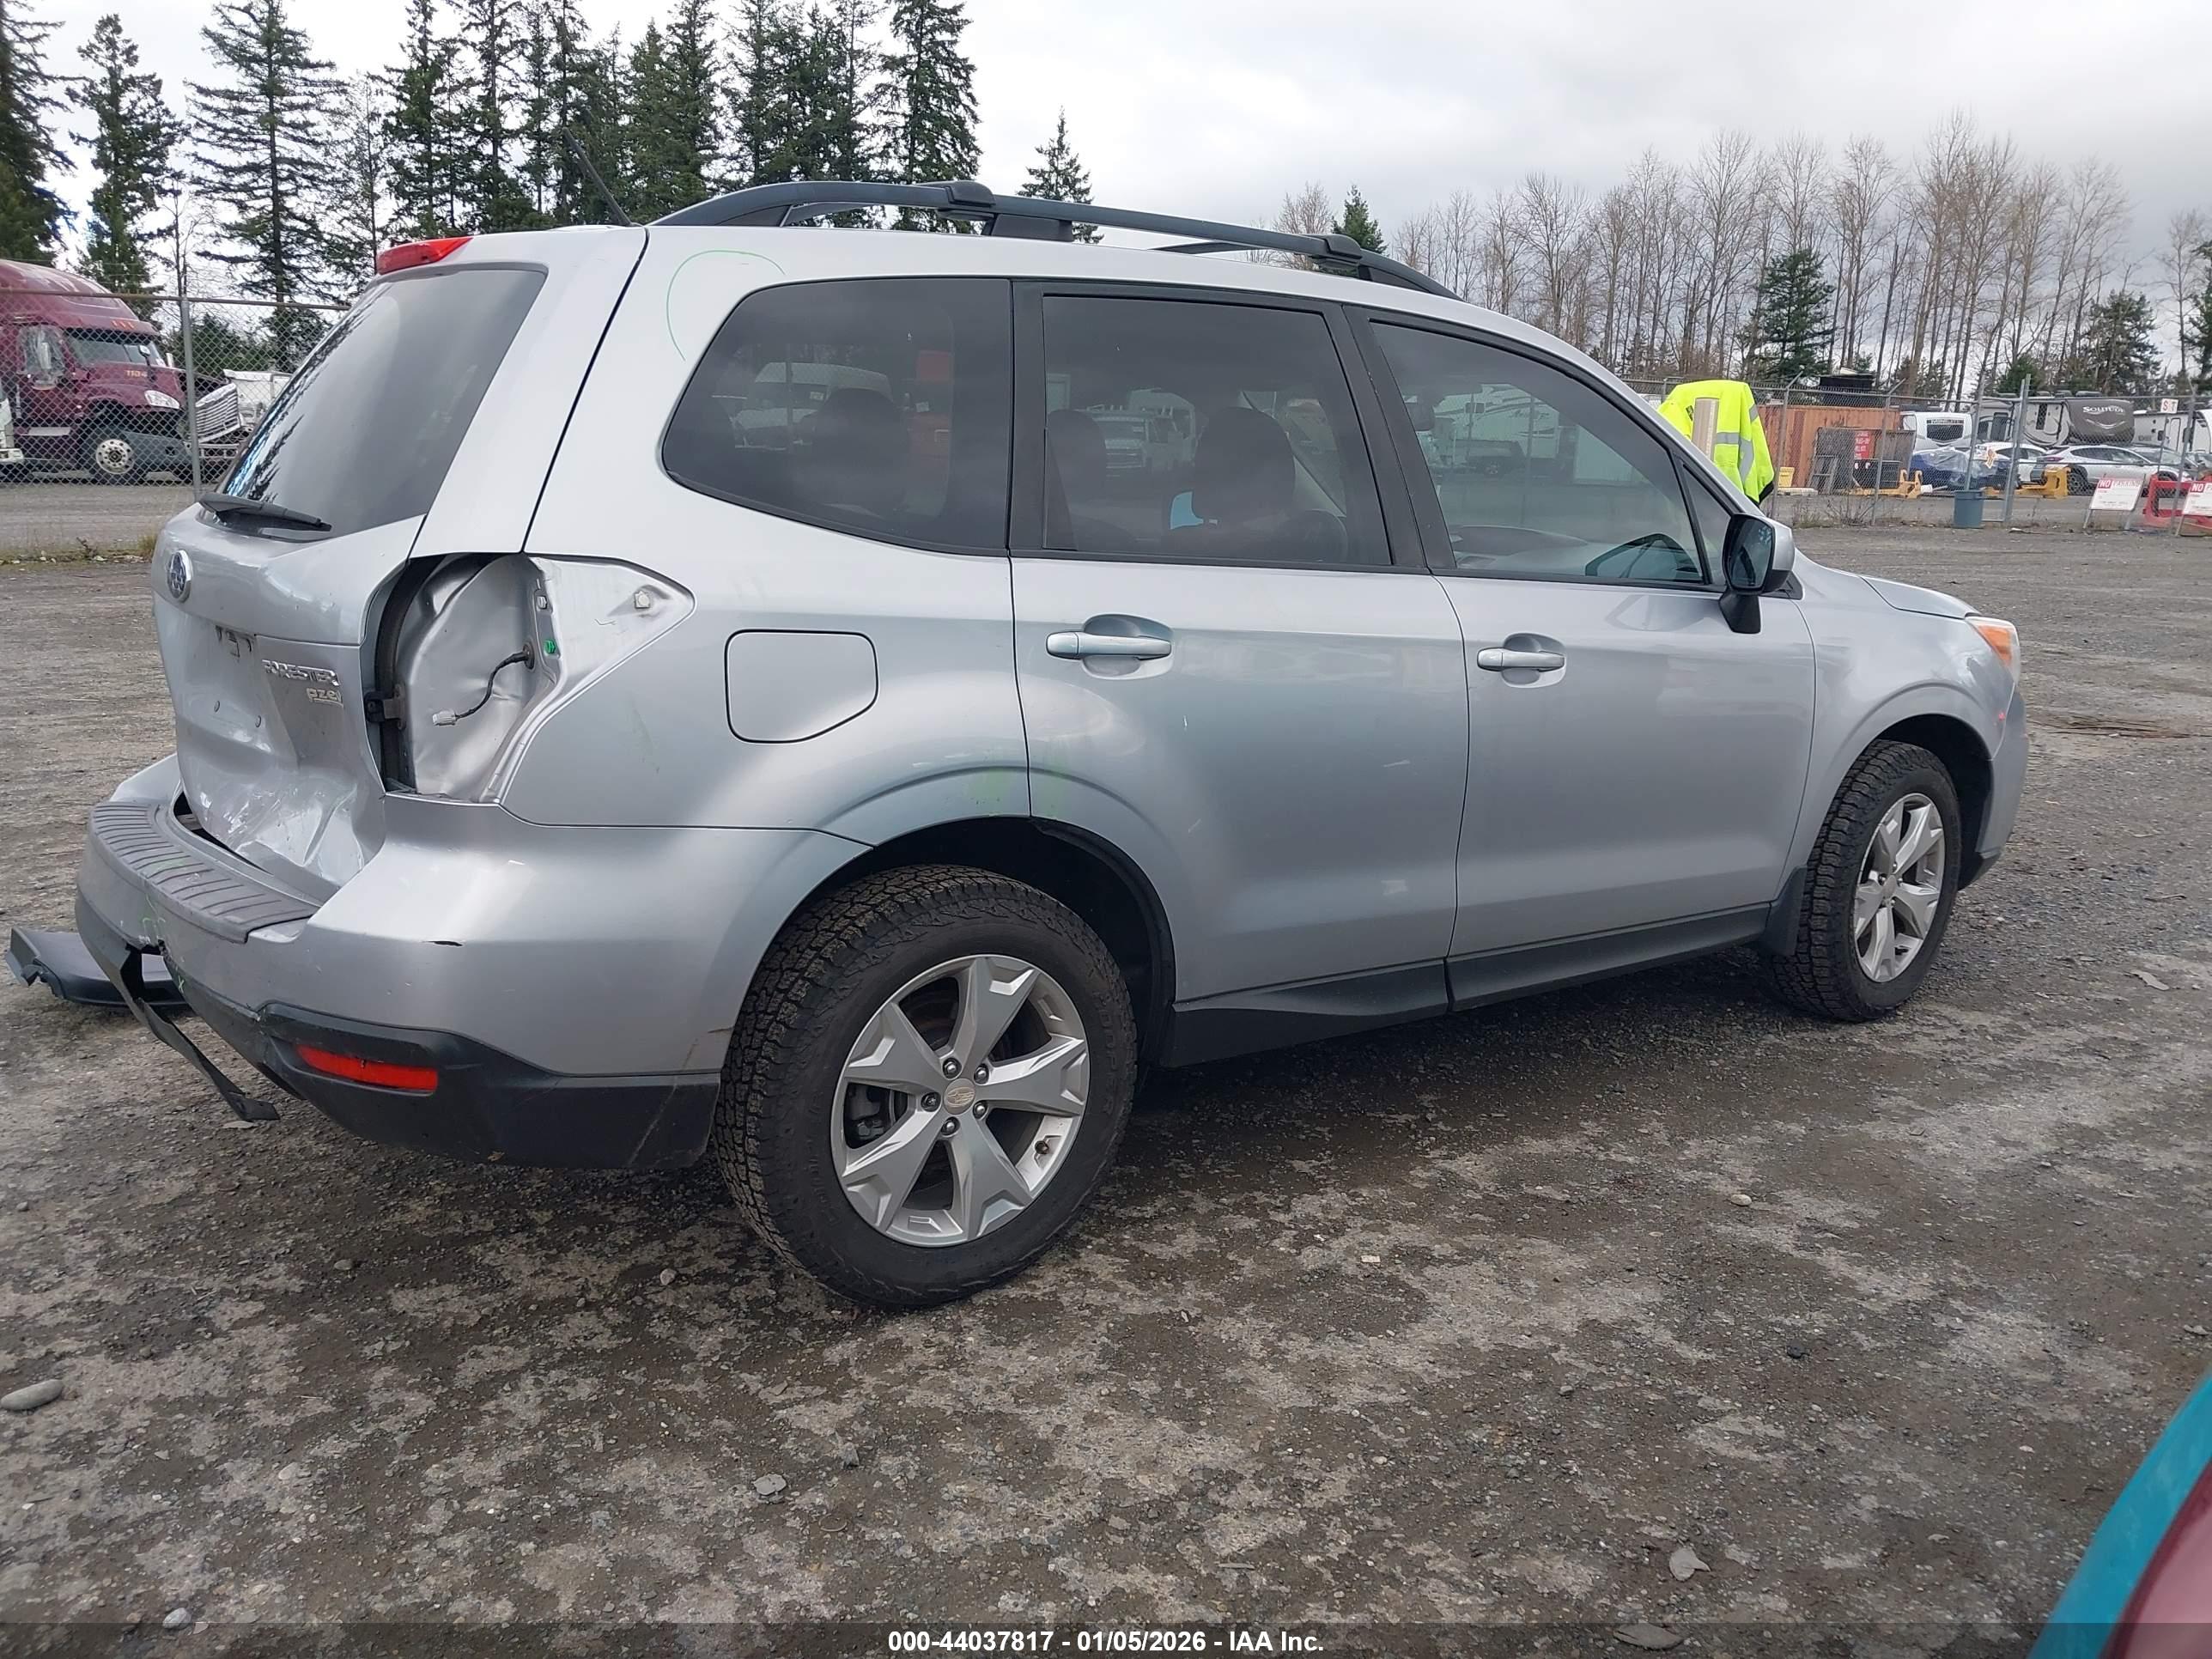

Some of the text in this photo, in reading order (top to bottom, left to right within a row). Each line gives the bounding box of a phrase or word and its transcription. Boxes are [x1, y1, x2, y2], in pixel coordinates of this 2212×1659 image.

[2099, 479, 2112, 489] NO
[2191, 483, 2204, 492] NO
[262, 659, 340, 686] FORESTER
